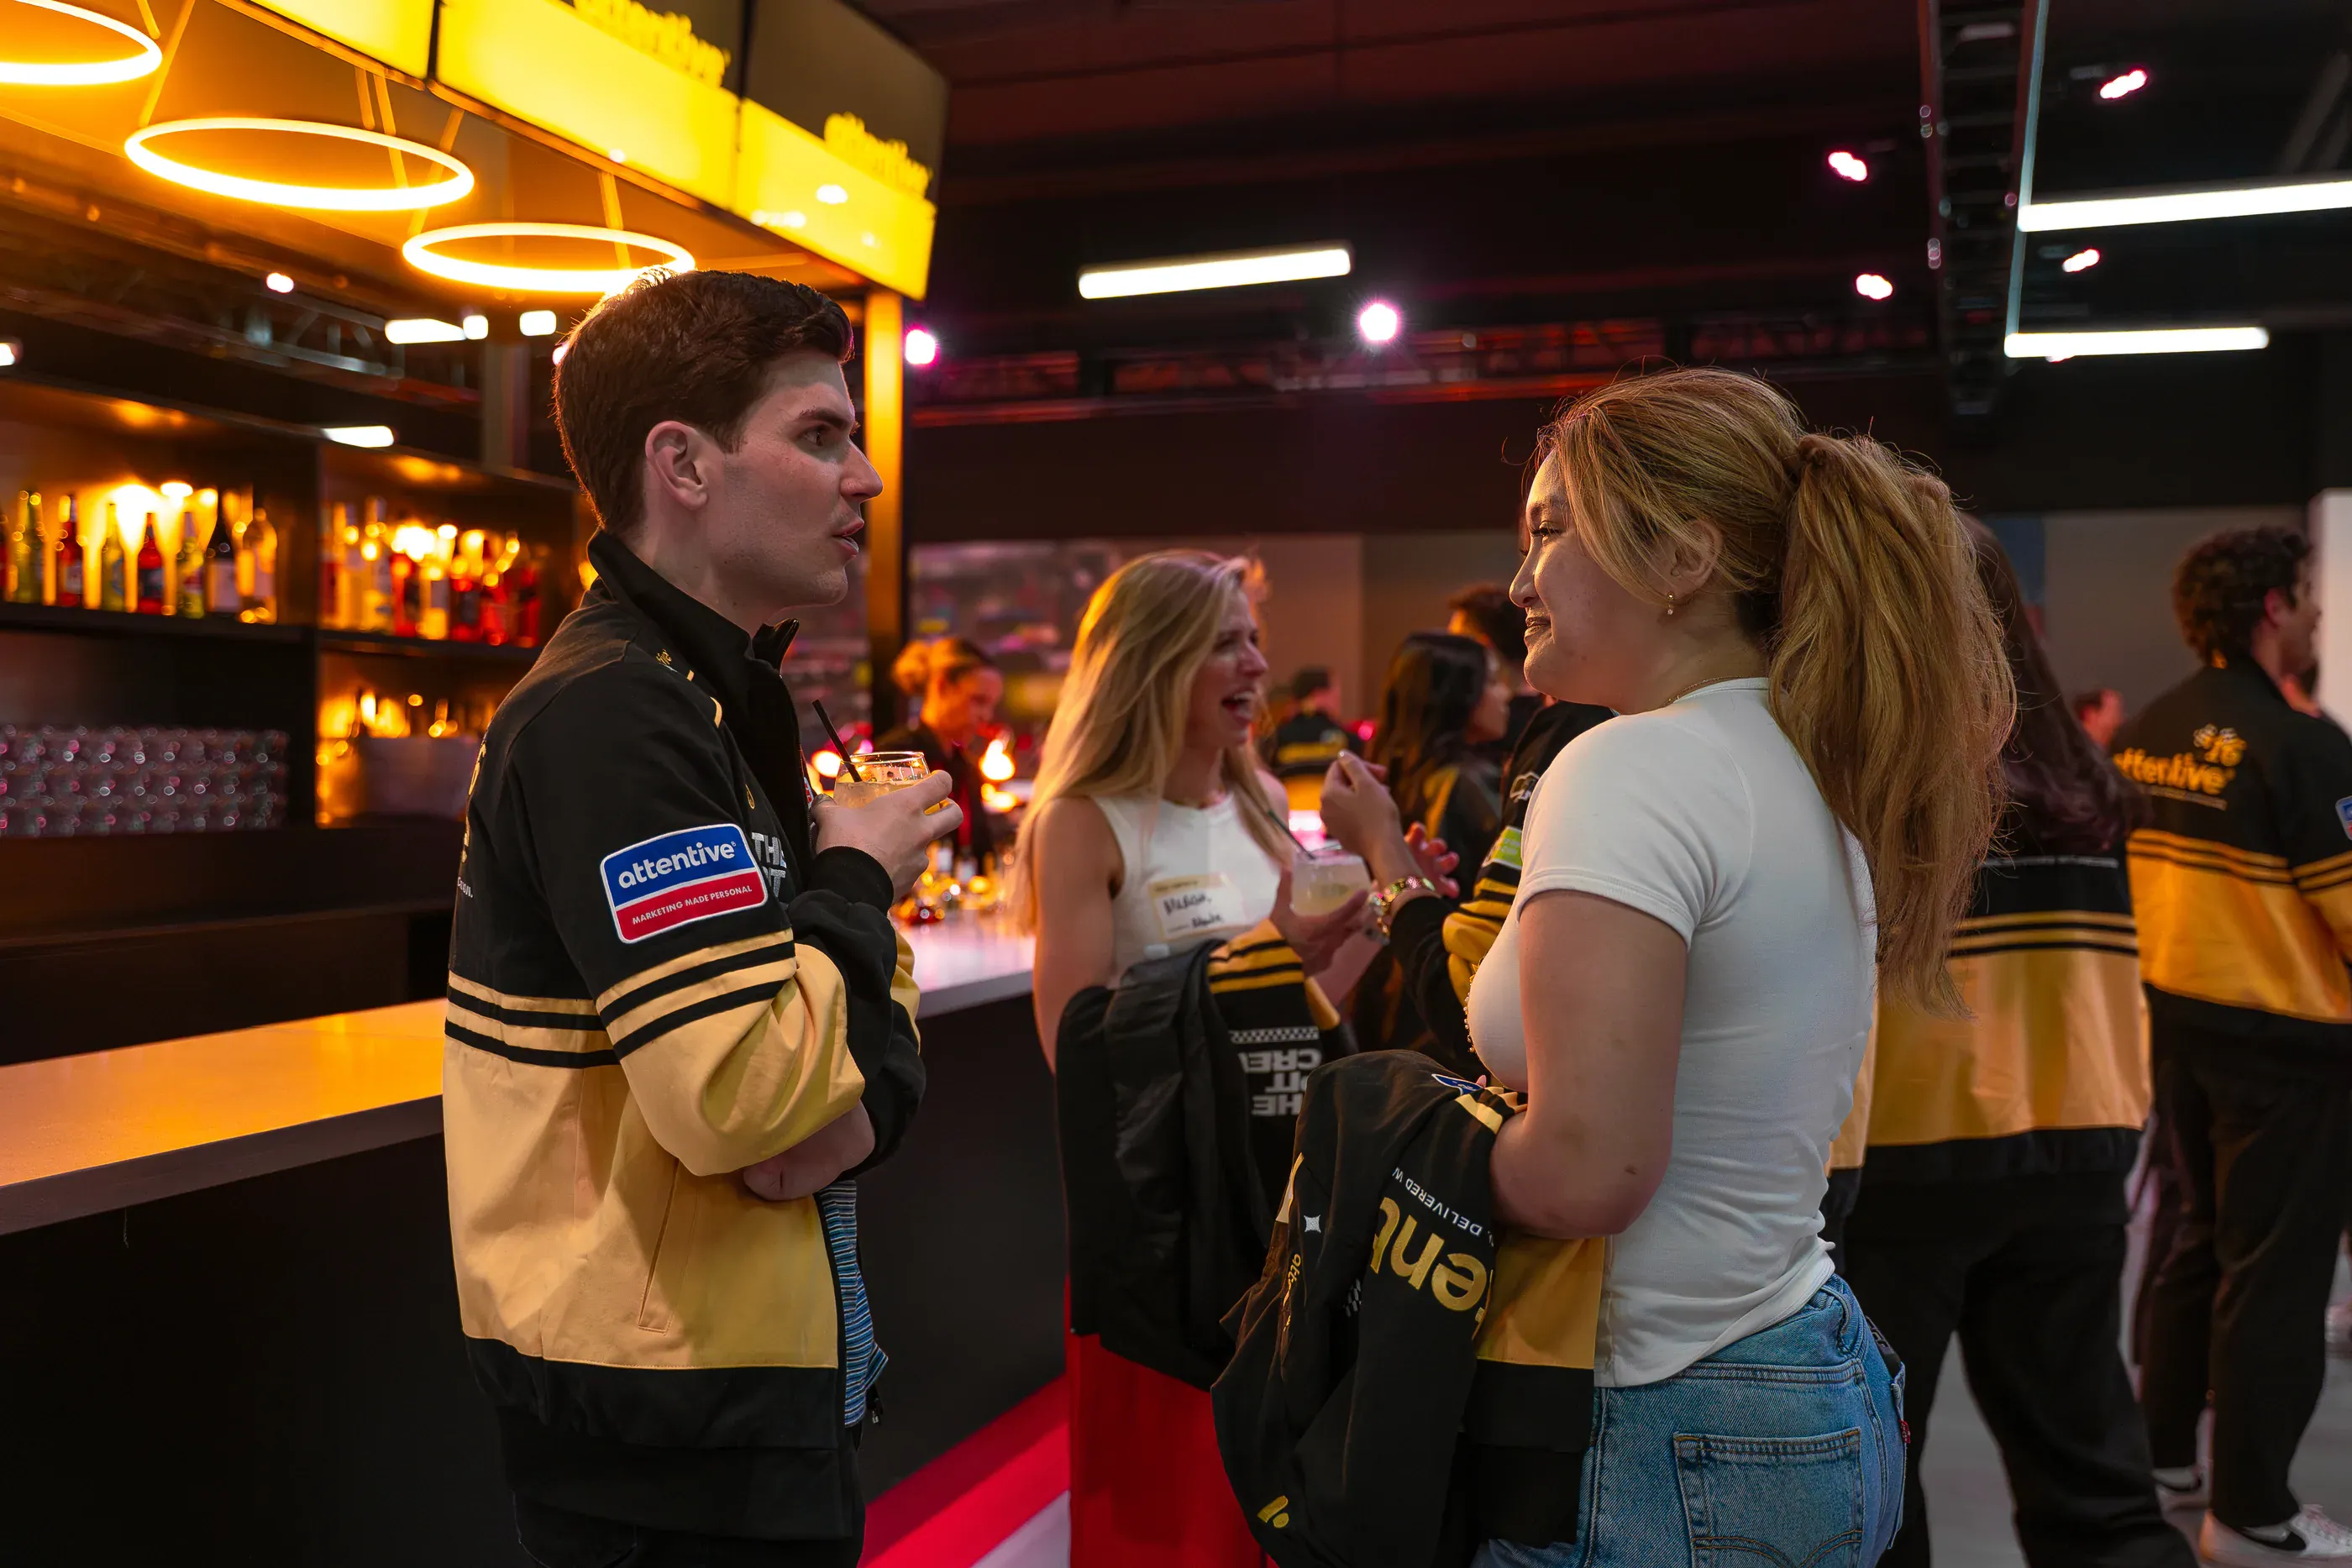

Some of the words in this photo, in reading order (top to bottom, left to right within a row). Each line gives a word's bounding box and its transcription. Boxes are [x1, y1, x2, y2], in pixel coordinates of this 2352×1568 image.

[632, 901, 684, 925] MARKETING
[685, 894, 710, 907] MADE
[710, 885, 753, 901] PERSONAL
[1251, 1093, 1304, 1117] HE
[1405, 1177, 1483, 1237] DELIVERED
